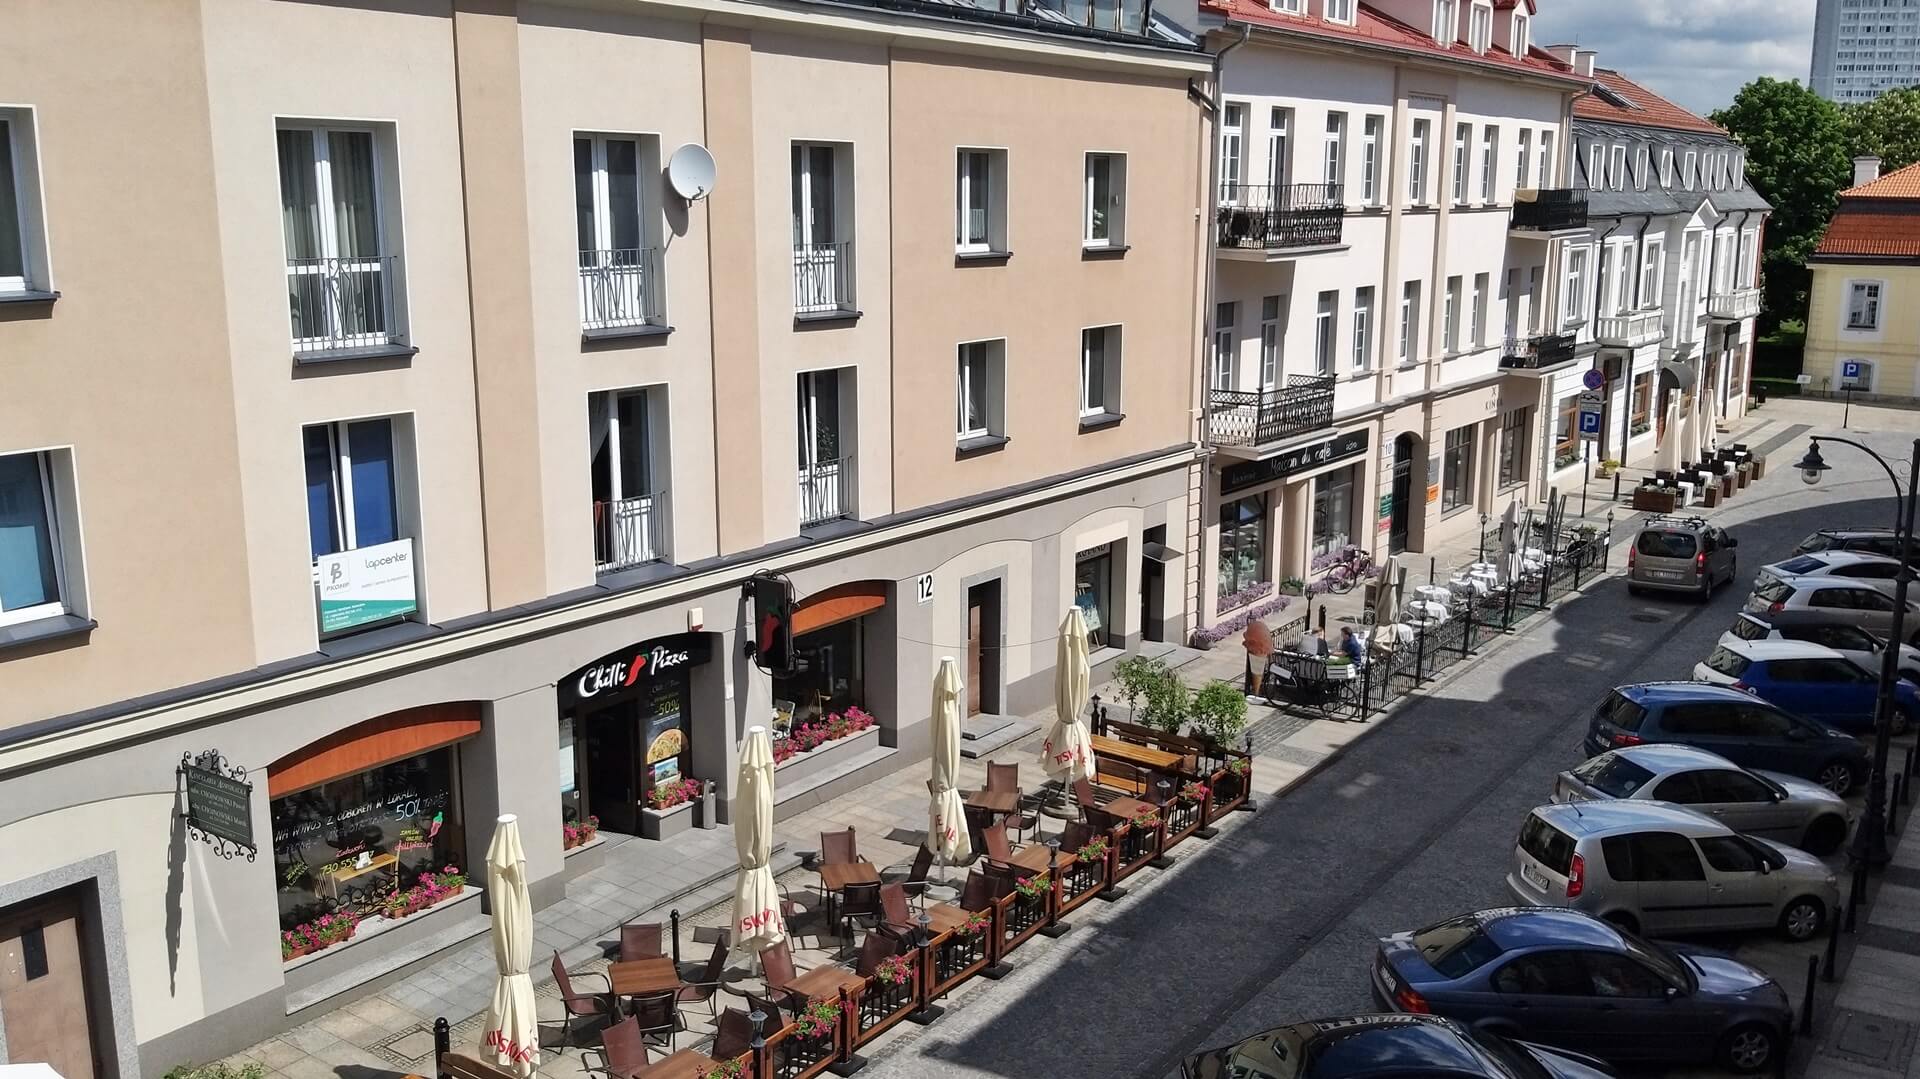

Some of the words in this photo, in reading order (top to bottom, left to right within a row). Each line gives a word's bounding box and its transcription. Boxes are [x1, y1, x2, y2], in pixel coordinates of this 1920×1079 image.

[1847, 364, 1856, 375] P
[1584, 414, 1596, 430] P
[1271, 456, 1297, 475] Maison
[1301, 447, 1311, 465] du
[1314, 440, 1332, 463] café
[1385, 443, 1393, 455] 10
[364, 552, 408, 569] lapcenter
[919, 574, 932, 599] 12
[579, 661, 627, 697] Chilli
[651, 645, 689, 676] Pizza
[395, 797, 421, 821] 50%
[275, 829, 289, 842] NA
[292, 821, 322, 837] WYNOS
[337, 802, 373, 822] ODBIOREM
[320, 862, 339, 876] 730
